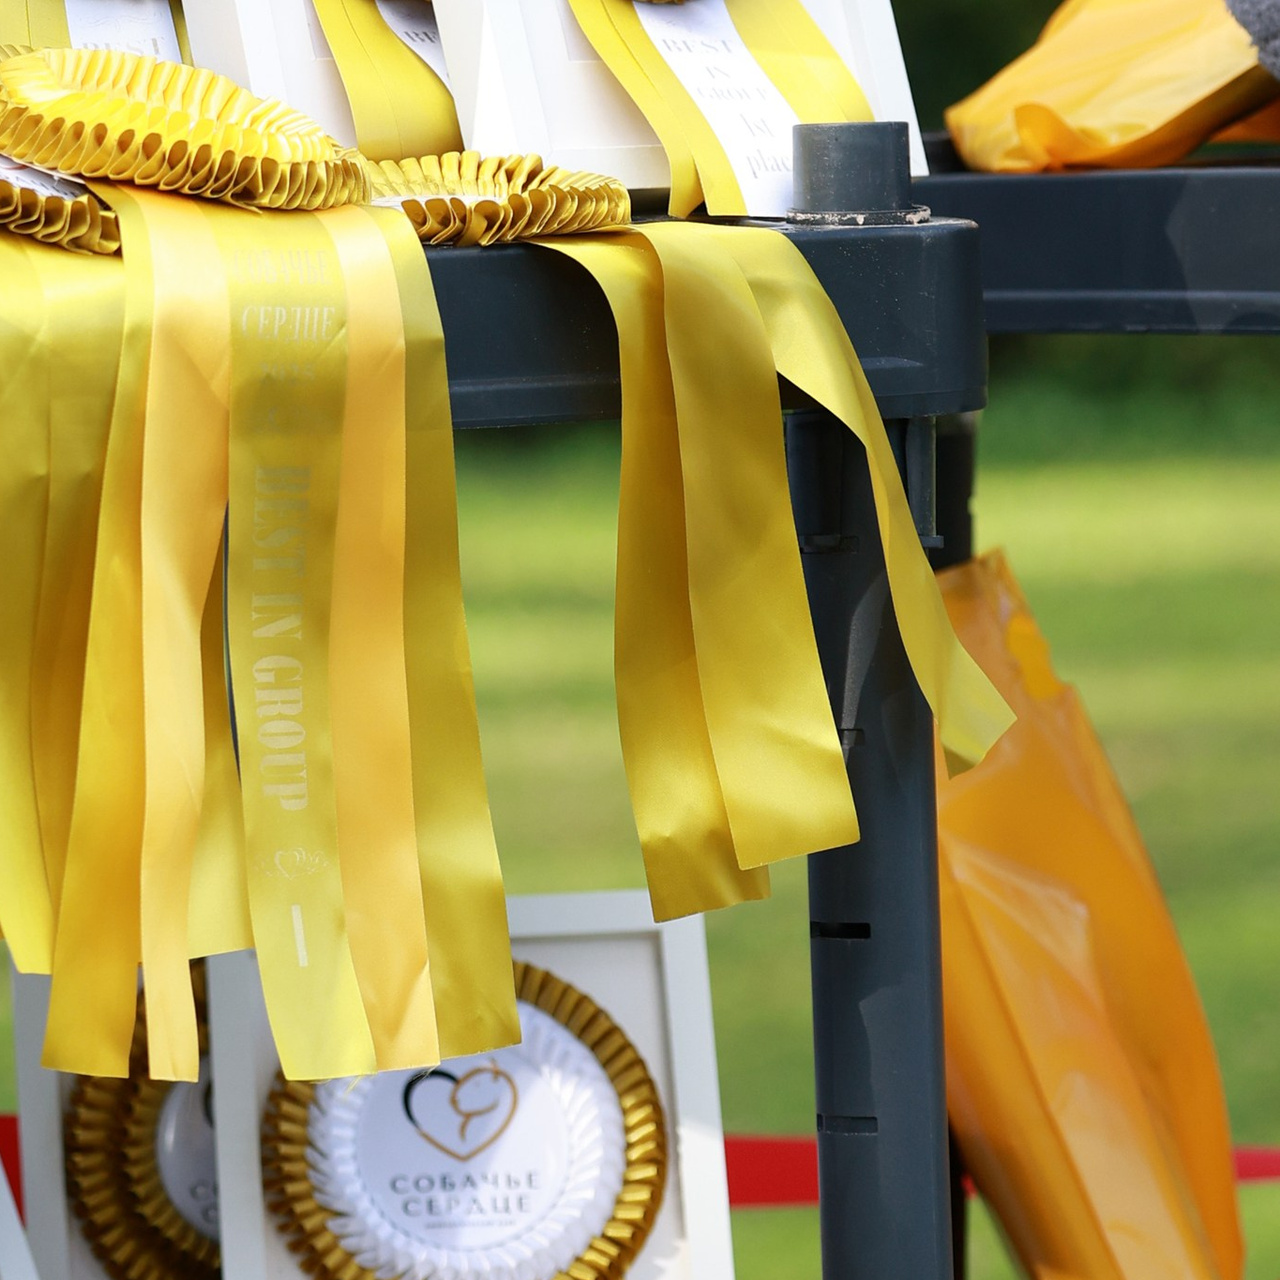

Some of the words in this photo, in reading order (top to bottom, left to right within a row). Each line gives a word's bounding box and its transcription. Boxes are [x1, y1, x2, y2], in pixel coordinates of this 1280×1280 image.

[662, 38, 734, 54] BEST
[746, 148, 792, 180] plac
[241, 305, 336, 345] СЕРДЦЕ
[251, 465, 312, 577] BEST
[251, 592, 303, 641] IN
[252, 655, 308, 812] GROUP
